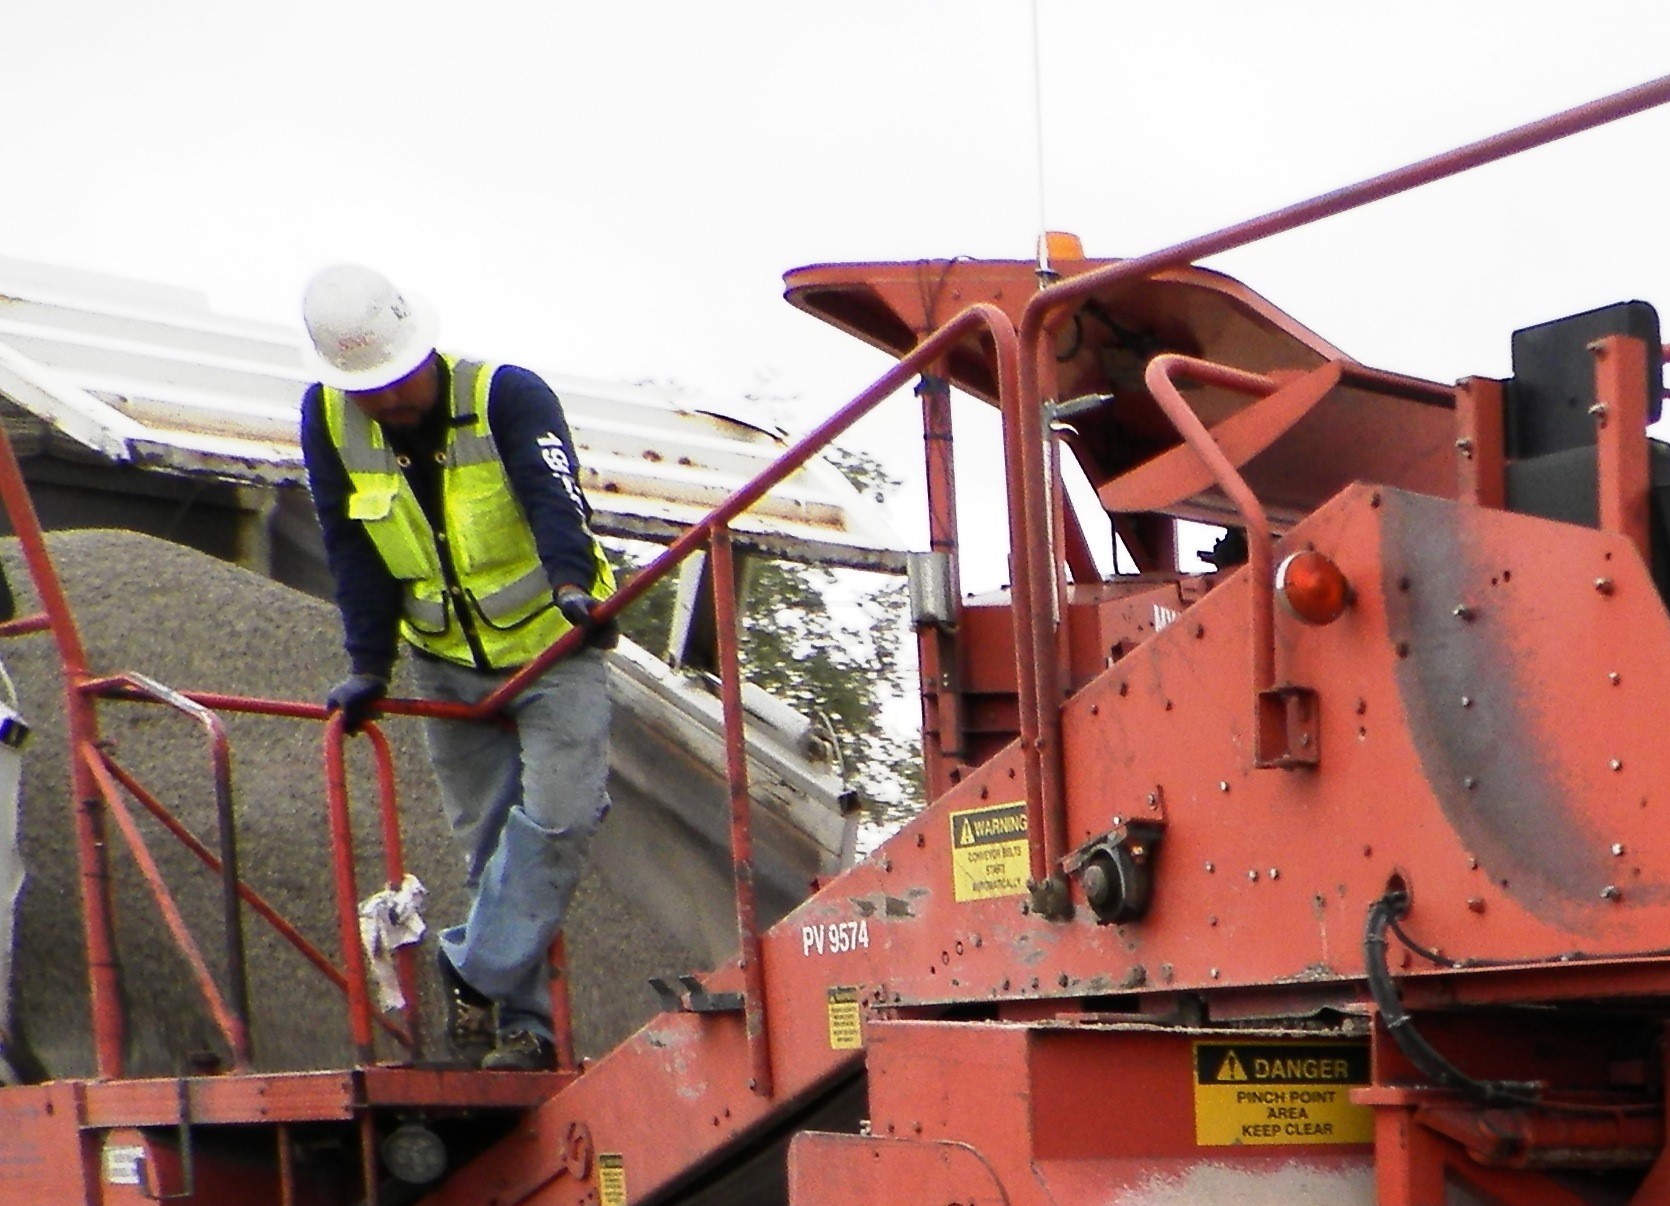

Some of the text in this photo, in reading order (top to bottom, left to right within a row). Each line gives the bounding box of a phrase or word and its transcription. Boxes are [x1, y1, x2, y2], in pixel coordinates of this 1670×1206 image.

[973, 813, 1028, 838] WARNING
[802, 919, 870, 957] PV 9574
[1254, 1058, 1349, 1080] DANGER
[1236, 1091, 1336, 1104] PINCH POINT
[1267, 1106, 1309, 1120] AREA
[1241, 1122, 1334, 1138] KEEP CLEAR
